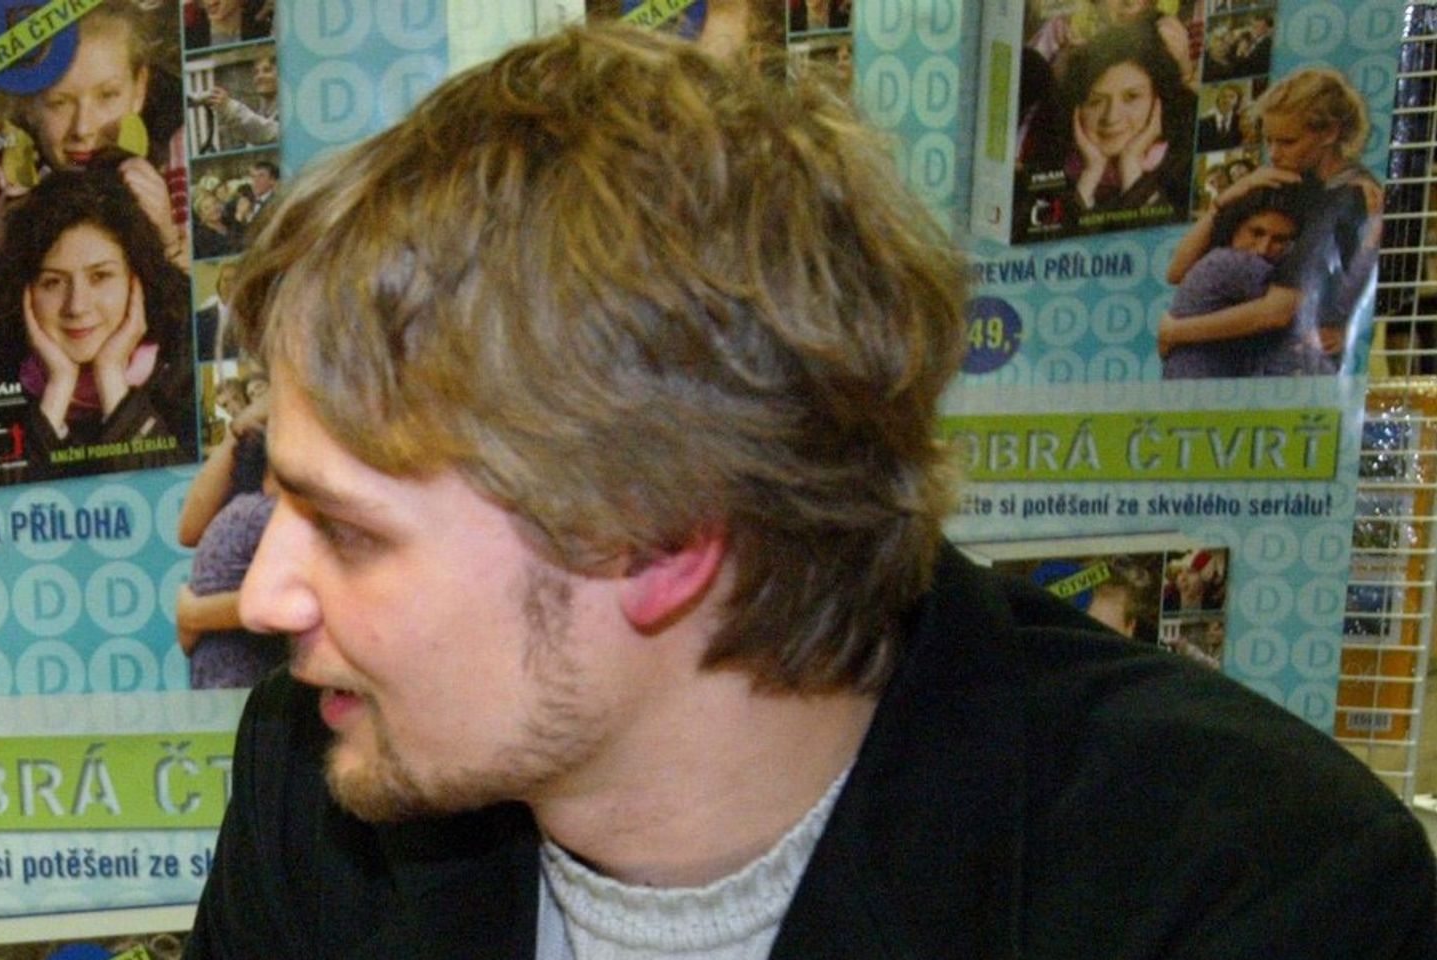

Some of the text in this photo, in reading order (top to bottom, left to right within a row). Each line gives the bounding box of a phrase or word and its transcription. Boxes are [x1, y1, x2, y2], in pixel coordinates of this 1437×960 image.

[27, 0, 96, 41] ČTVR
[1128, 413, 1331, 470] ČTVRŤ
[11, 503, 131, 542] PŘÍLOHA
[1116, 499, 1139, 516] ze
[1147, 492, 1241, 516] skvělého
[1249, 491, 1332, 516] seriálu!
[23, 848, 138, 884] potěšení
[149, 855, 179, 878] ze
